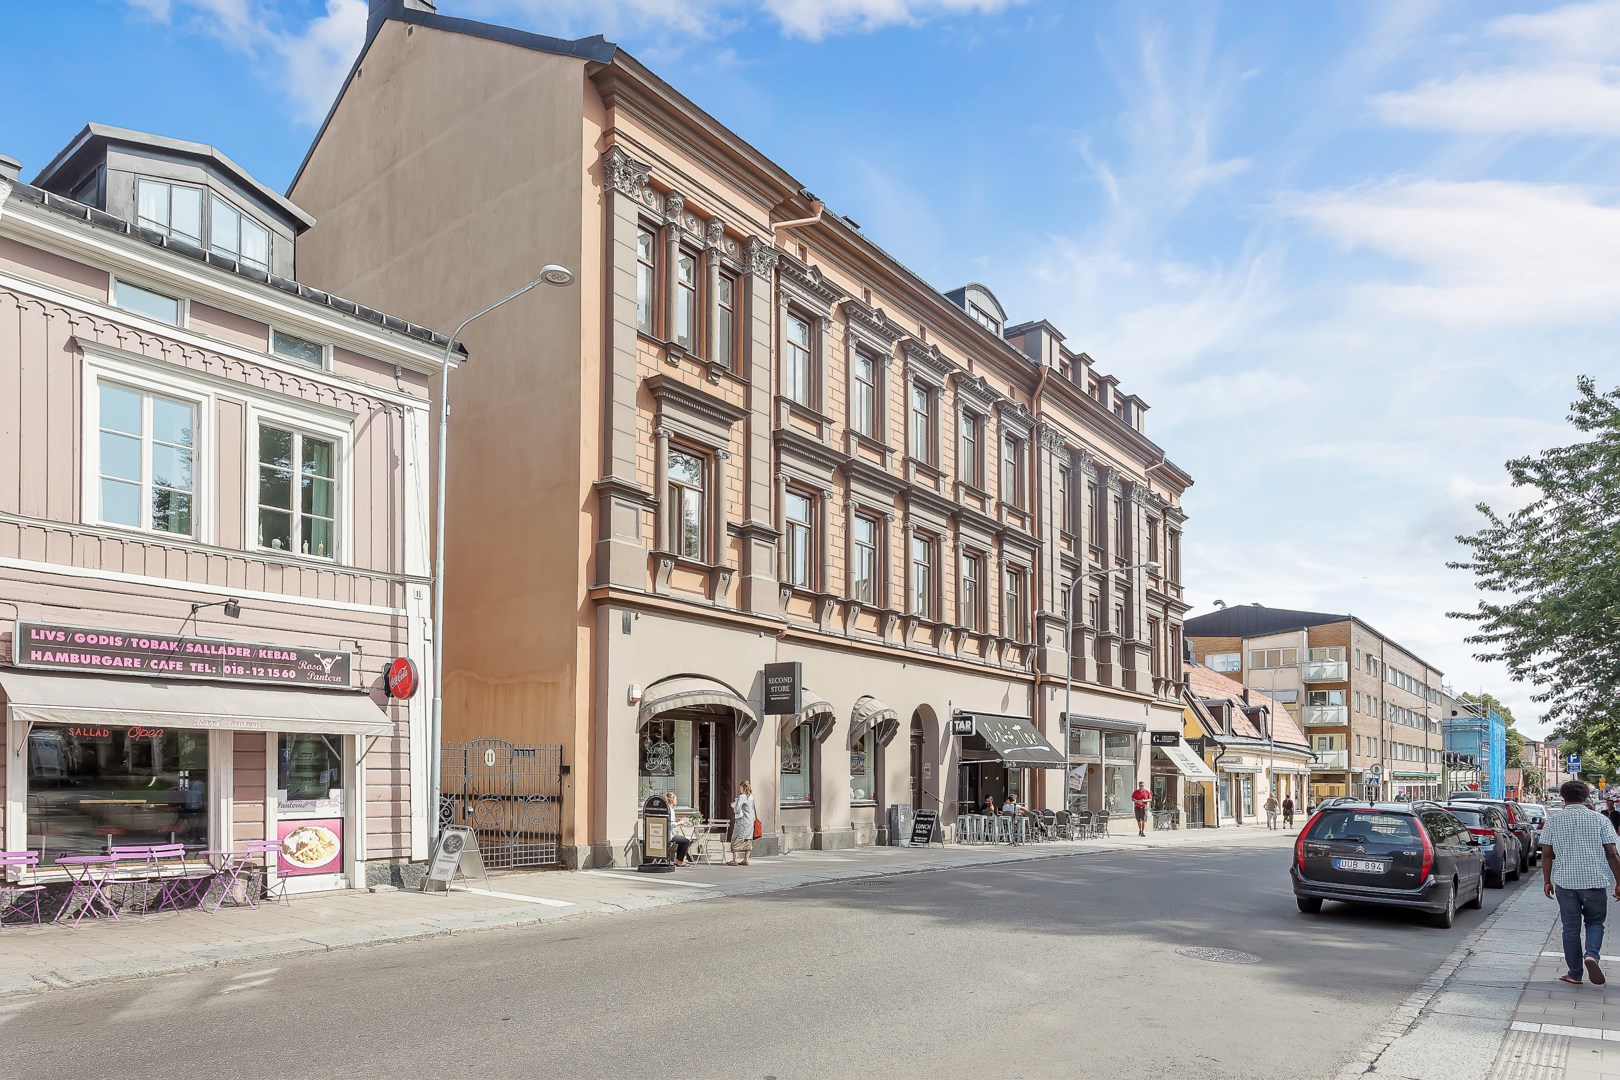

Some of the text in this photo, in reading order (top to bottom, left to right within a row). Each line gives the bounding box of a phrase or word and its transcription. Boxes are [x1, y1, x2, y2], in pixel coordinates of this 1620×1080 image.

[31, 629, 65, 642] LIVS
[74, 633, 123, 647] GODIS
[131, 638, 179, 651] TOBAK
[186, 643, 251, 657] SALLADER
[258, 650, 298, 661] KEBAB
[31, 651, 141, 668] HAMBURGARE
[150, 659, 183, 671] CAFE
[190, 663, 216, 673] TEL:
[298, 660, 323, 671] Rosa
[306, 671, 342, 682] Pantern
[768, 676, 793, 684] SECOND
[954, 720, 972, 730] TAR
[68, 727, 110, 738] SALLAD
[127, 726, 164, 741] Open
[1341, 860, 1382, 870] UUB 894
